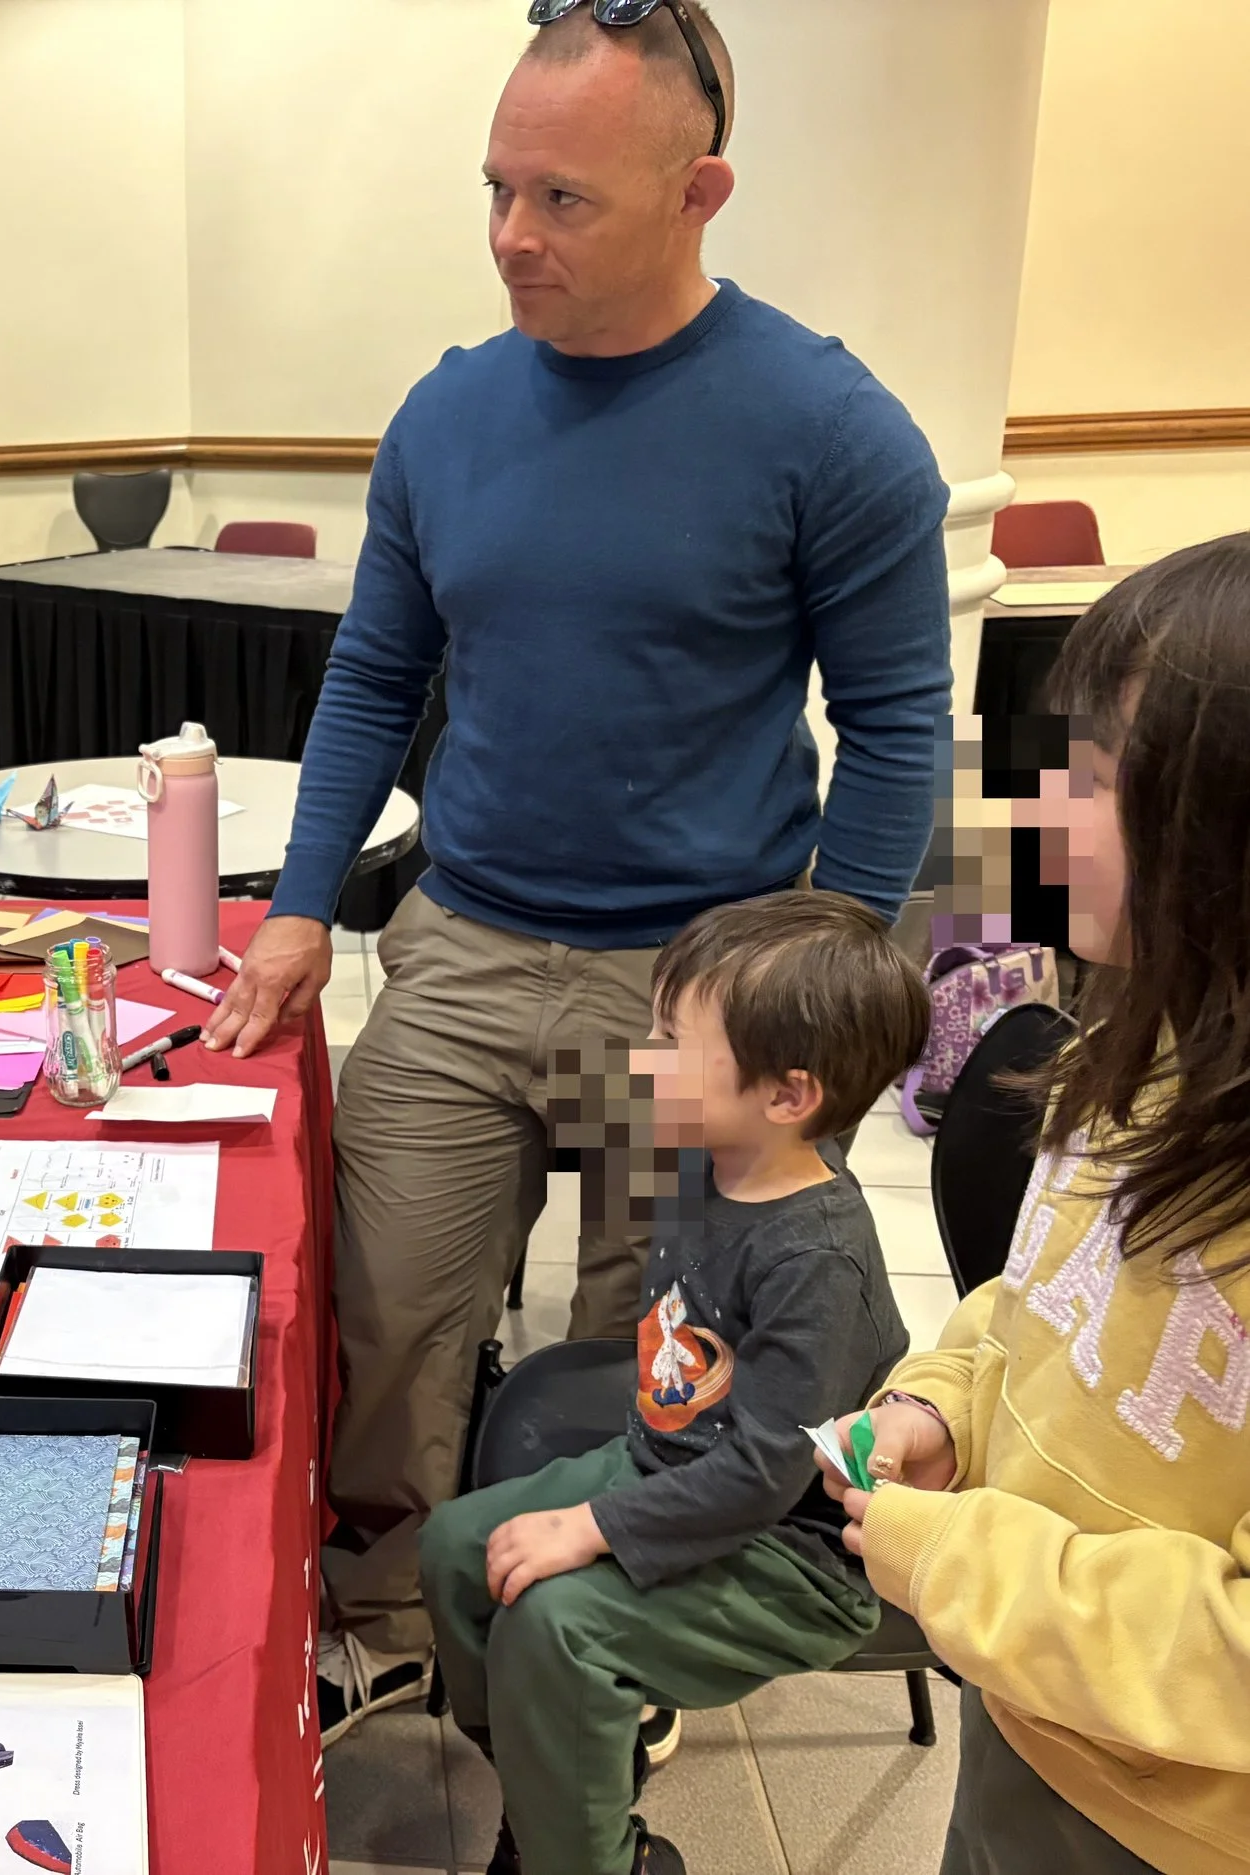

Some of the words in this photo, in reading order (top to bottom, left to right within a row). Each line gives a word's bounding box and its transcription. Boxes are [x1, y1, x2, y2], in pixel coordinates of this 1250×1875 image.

[74, 1756, 82, 1779] designed
[73, 1780, 81, 1796] Dress
[76, 1822, 86, 1832] Bag
[76, 1832, 84, 1843] Air
